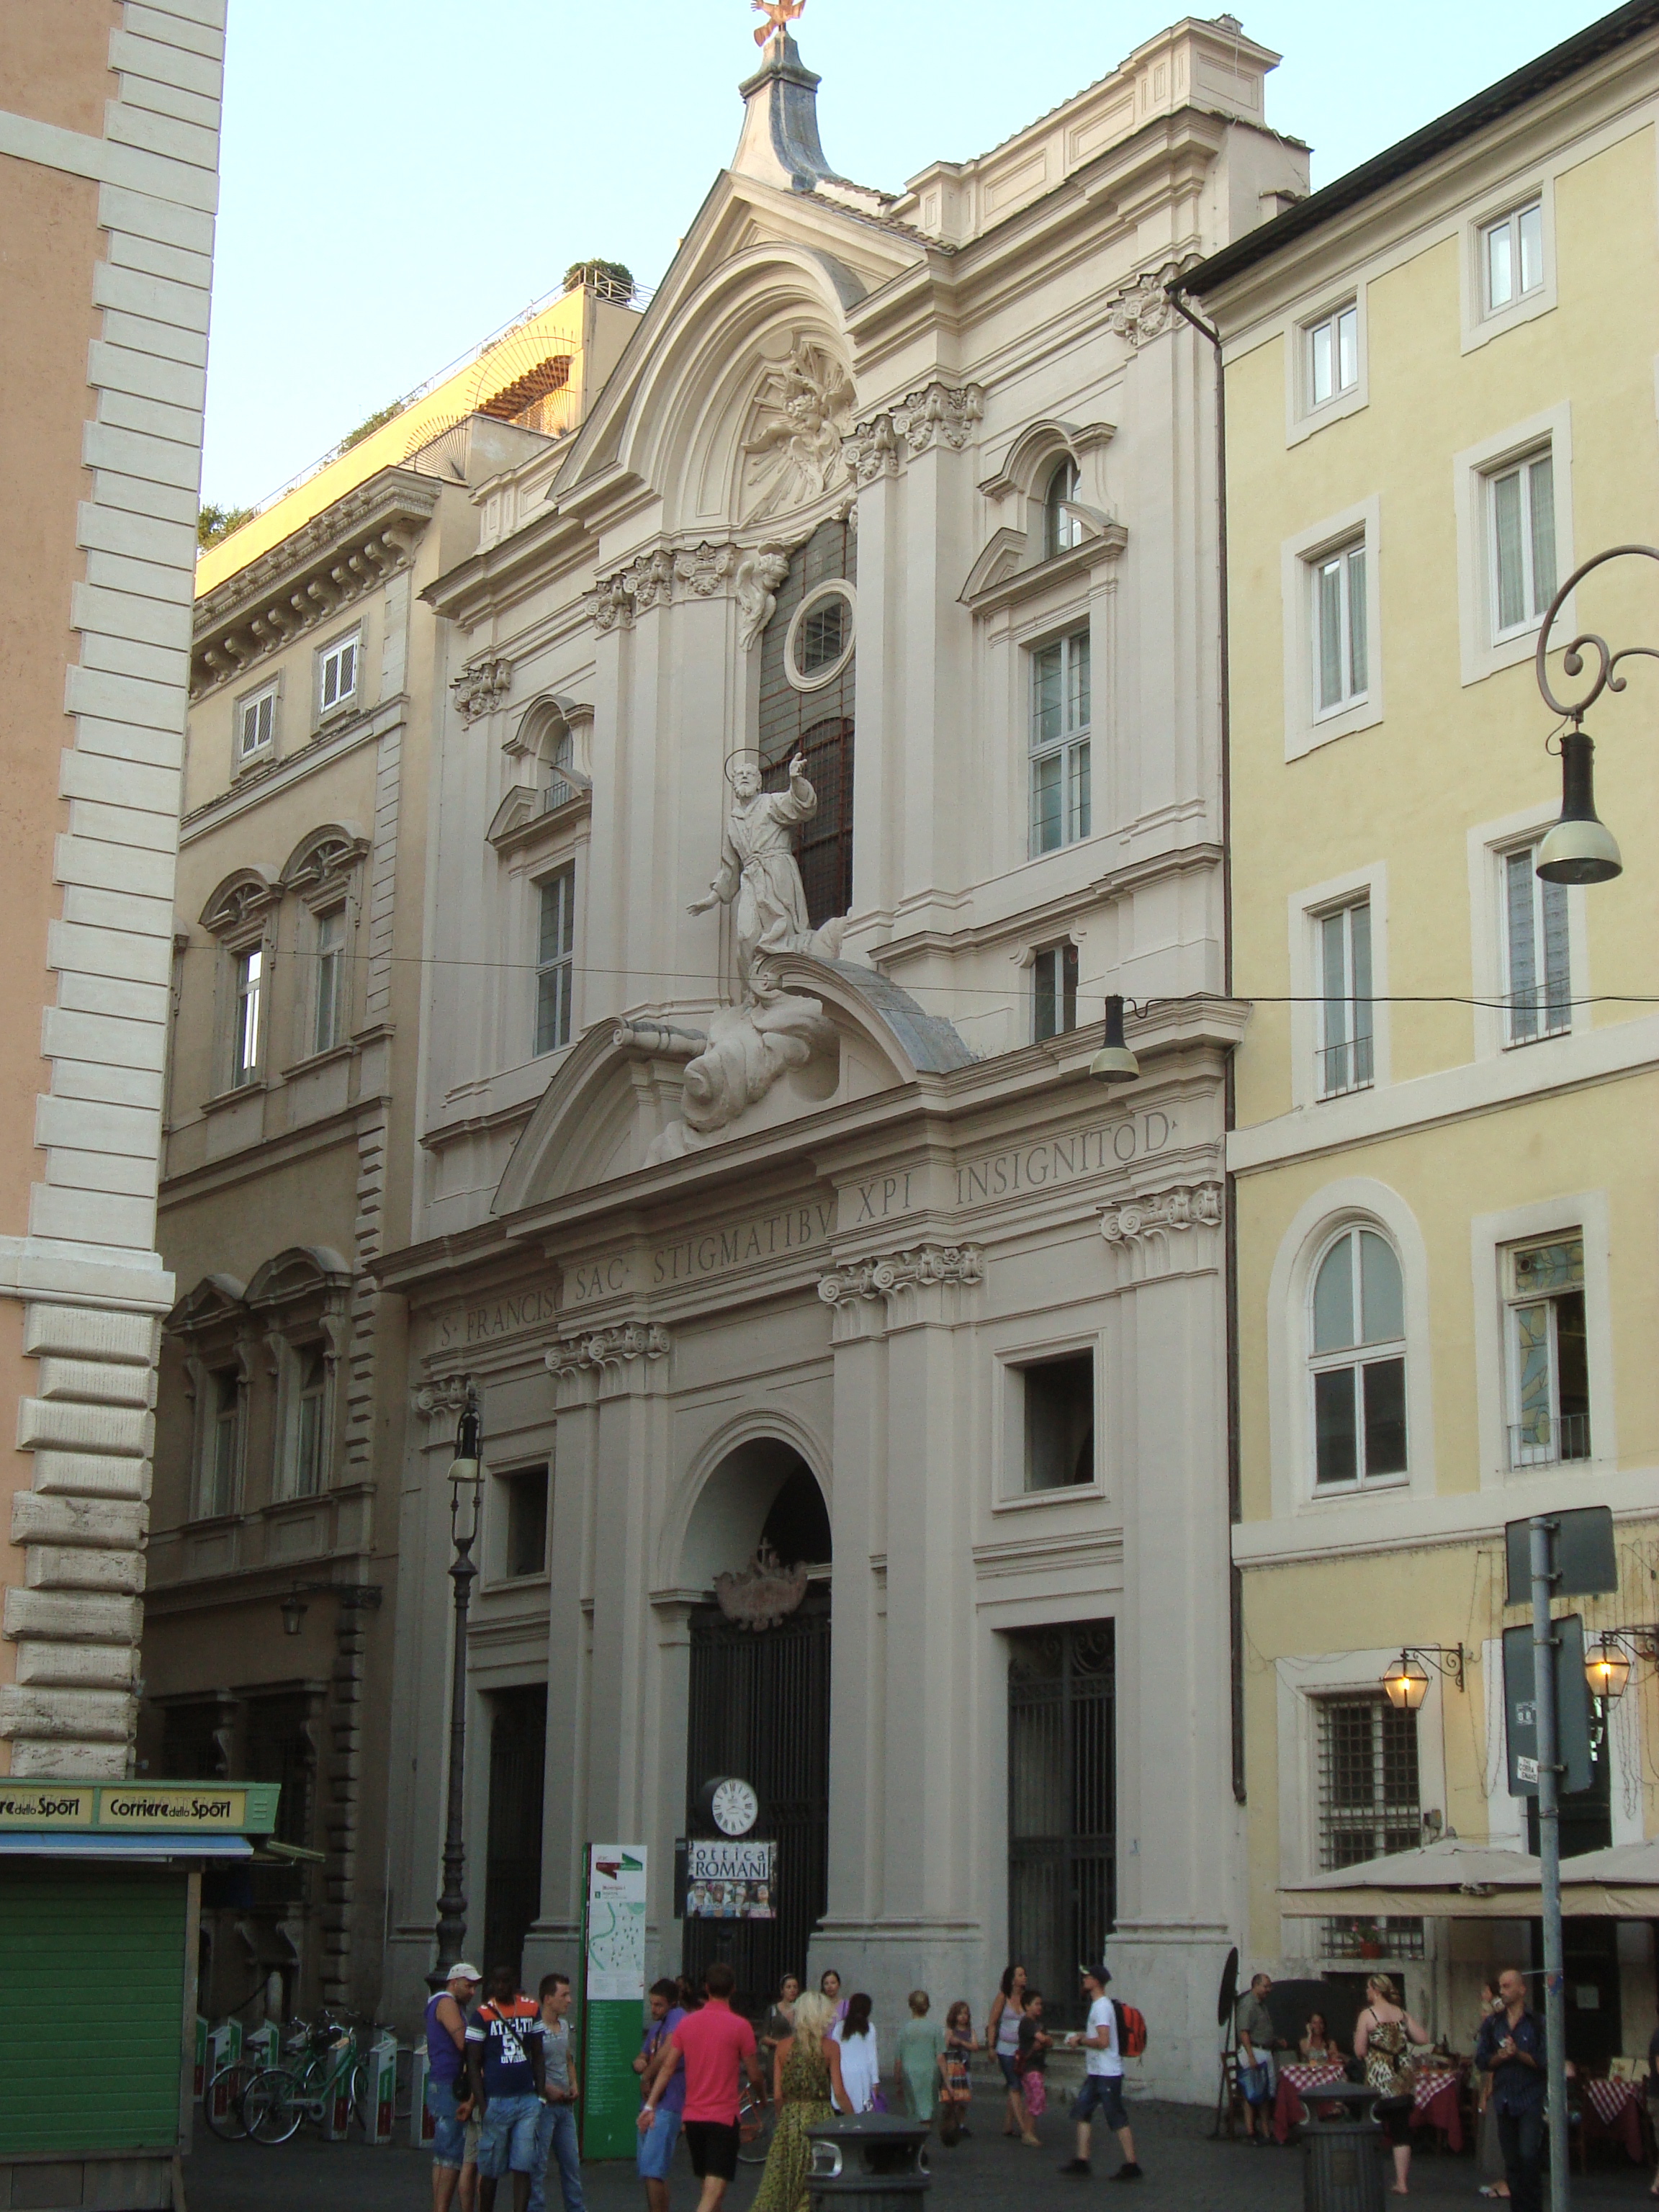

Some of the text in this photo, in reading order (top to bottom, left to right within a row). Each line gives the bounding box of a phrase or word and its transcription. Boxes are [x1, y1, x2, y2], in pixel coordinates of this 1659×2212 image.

[856, 1172, 912, 1223] XPI
[37, 1797, 80, 1817] Sport
[110, 1799, 169, 1817] Corriere
[191, 1800, 231, 1820] Sport
[696, 1847, 765, 1861] ottica
[696, 1861, 765, 1877] ROMANI
